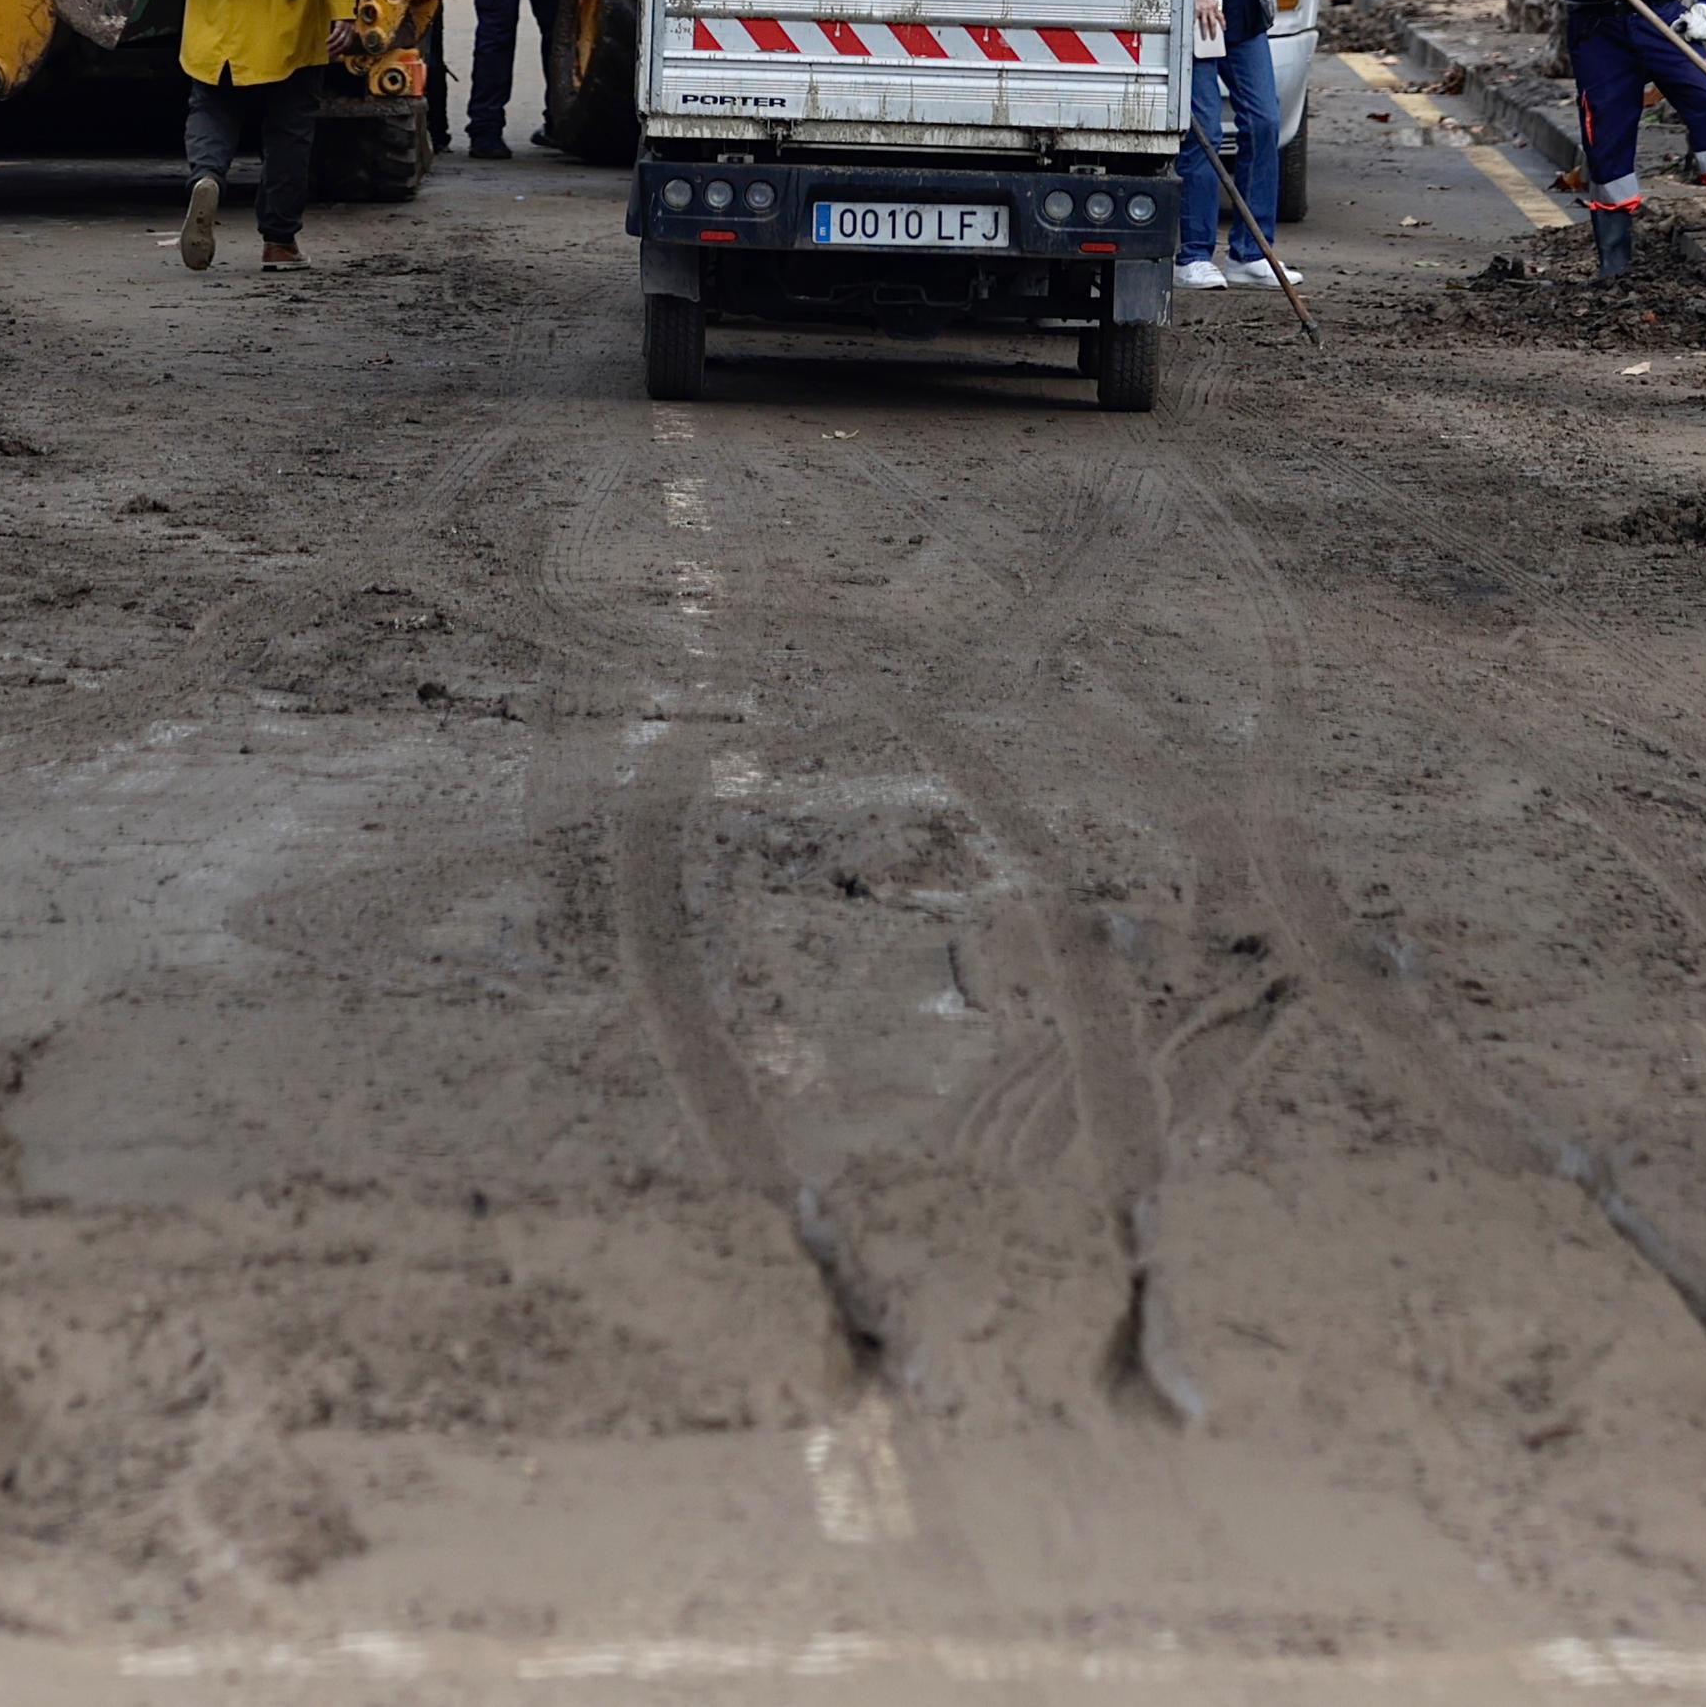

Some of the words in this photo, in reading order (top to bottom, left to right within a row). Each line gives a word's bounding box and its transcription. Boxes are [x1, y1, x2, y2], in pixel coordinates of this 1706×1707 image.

[681, 93, 787, 108] PORTER
[839, 207, 924, 240] 0010
[937, 210, 1000, 241] LFJ
